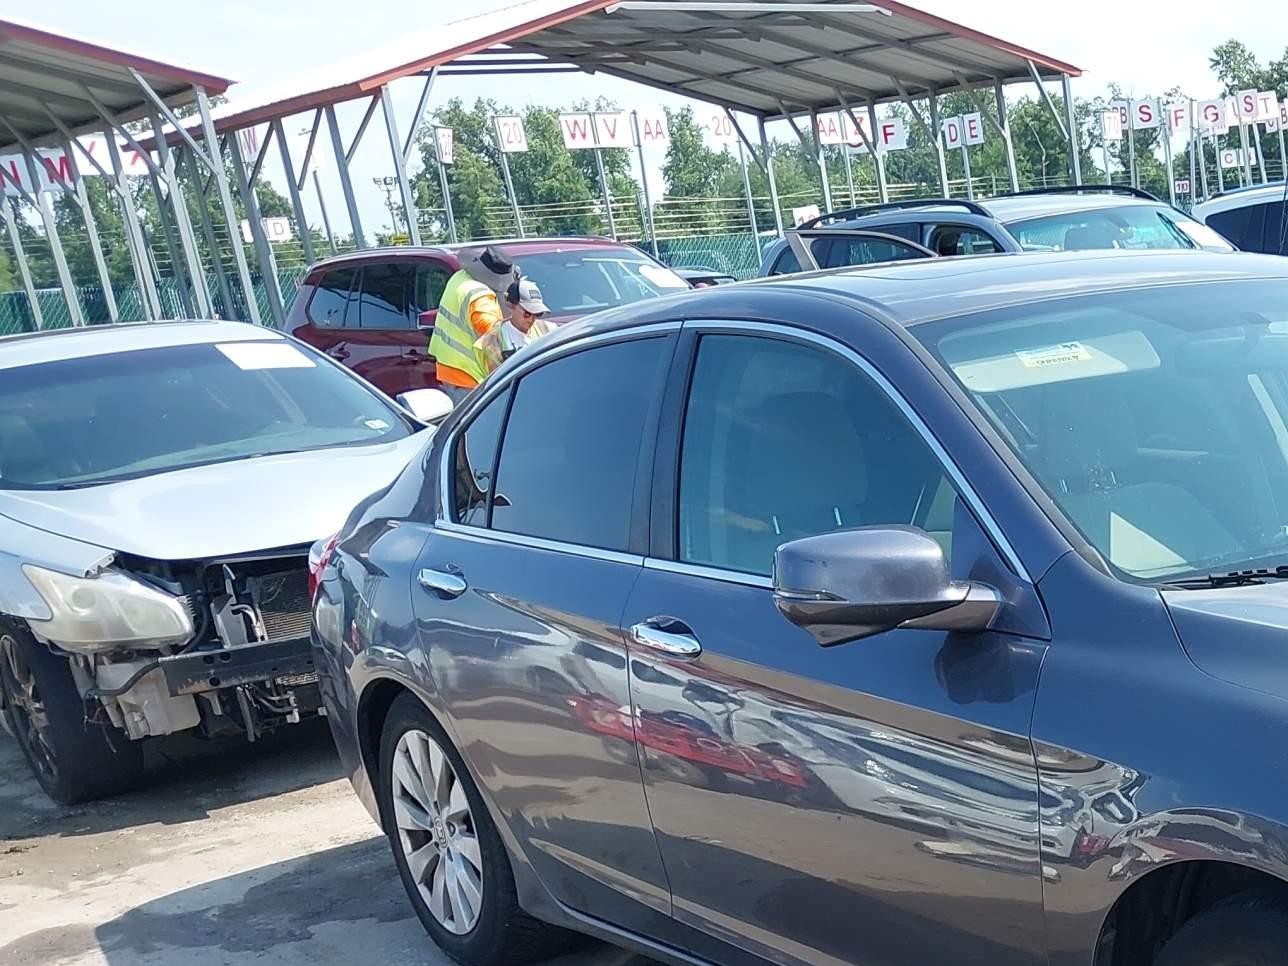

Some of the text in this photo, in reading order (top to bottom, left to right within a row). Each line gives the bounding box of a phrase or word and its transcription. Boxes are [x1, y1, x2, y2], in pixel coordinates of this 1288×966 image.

[1138, 104, 1153, 123] S
[1203, 104, 1219, 123] G
[1243, 95, 1254, 113] S
[1258, 97, 1272, 114] T
[1173, 108, 1185, 127] F
[502, 122, 522, 144] 20
[564, 119, 586, 140] W
[603, 118, 616, 139] V
[643, 119, 665, 140] AA
[881, 124, 895, 145] F
[948, 123, 959, 143] D
[968, 119, 979, 139] E
